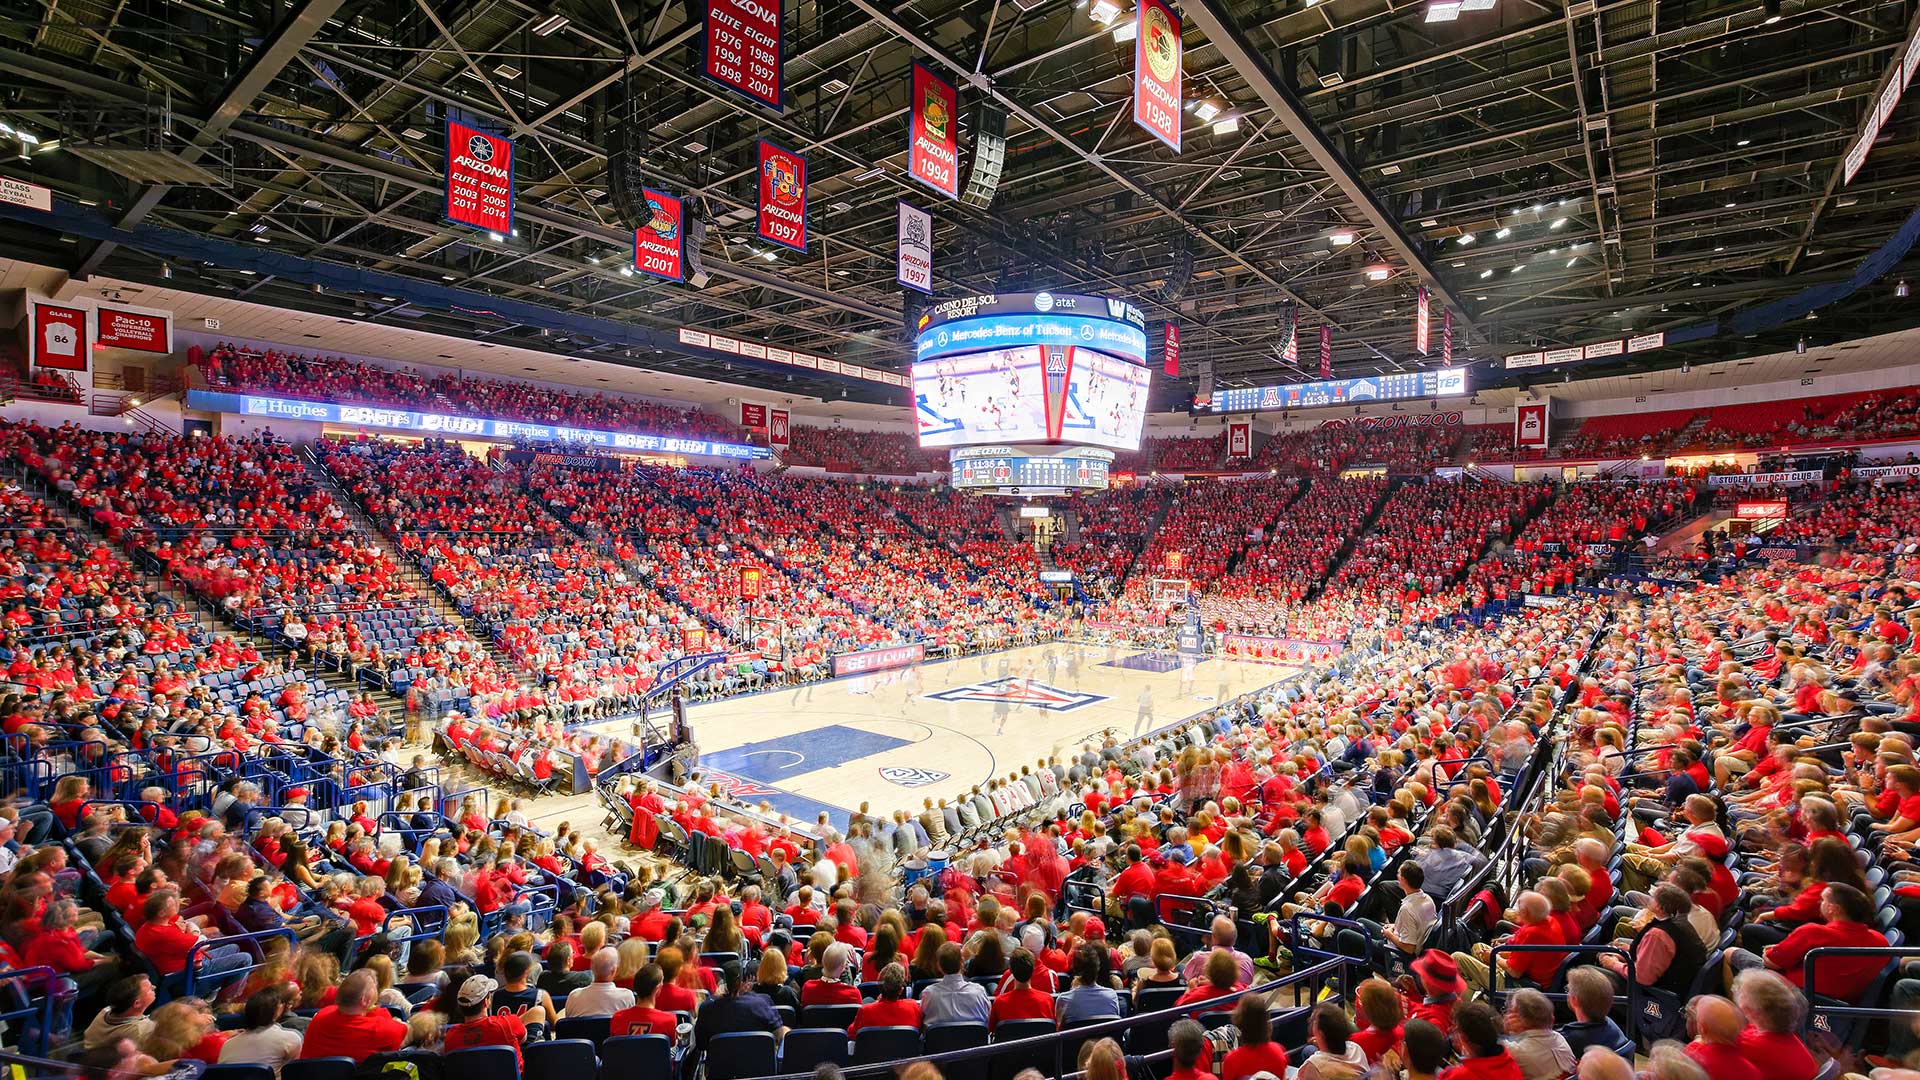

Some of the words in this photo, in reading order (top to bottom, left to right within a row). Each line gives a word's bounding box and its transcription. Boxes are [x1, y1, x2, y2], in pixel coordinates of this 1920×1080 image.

[731, 0, 777, 27] ZONA
[710, 8, 742, 30] ELITE
[744, 26, 776, 48] EIGHT
[715, 28, 742, 50] 1976
[749, 45, 775, 66] 1988
[715, 45, 741, 66] 1994
[749, 62, 775, 81] 1997
[715, 62, 742, 83] 1998
[747, 77, 774, 98] 2001
[1141, 74, 1178, 111] ARIZONA
[1145, 101, 1172, 134] 1988
[915, 136, 955, 165] ARIZONA
[454, 155, 508, 180] ARIZONA
[764, 160, 798, 186] Final
[921, 158, 949, 184] 1994
[4, 181, 31, 193] GLASS
[452, 172, 478, 186] ELITE
[480, 181, 508, 195] EIGHT
[771, 177, 803, 199] Four
[453, 186, 478, 200] 2003
[483, 194, 506, 208] 2005
[453, 197, 477, 211] 2011
[482, 205, 506, 219] 2014
[763, 203, 803, 224] ARIZONA
[769, 221, 797, 240] 1997
[639, 240, 679, 258] ARIZONA
[643, 255, 673, 273] 2001
[901, 253, 929, 269] ARIZONA
[905, 268, 926, 283] 1997
[934, 299, 961, 315] CASINO
[962, 297, 977, 308] DEL
[979, 294, 998, 306] SOL
[947, 306, 978, 320] RESORT
[49, 310, 73, 319] GLASS
[115, 315, 151, 327] Pac-10
[111, 322, 155, 333] CONFERENCE
[951, 327, 1020, 342] Mercedes-Benz
[1021, 324, 1034, 337] of
[1035, 324, 1072, 337] Tucson
[54, 334, 69, 344] 86
[1439, 377, 1461, 389] TEP
[267, 399, 328, 417] Hughes
[508, 423, 549, 438] Hughes
[1525, 421, 1537, 429] 25
[720, 444, 750, 456] Hughes
[1718, 475, 1753, 484] STUDENT
[1755, 474, 1790, 483] WILDCAT
[1791, 472, 1812, 481] CLUB
[1859, 468, 1891, 477] STUDENT
[1757, 547, 1798, 560] ARIZONA
[746, 581, 757, 595] 33
[847, 655, 872, 670] GET
